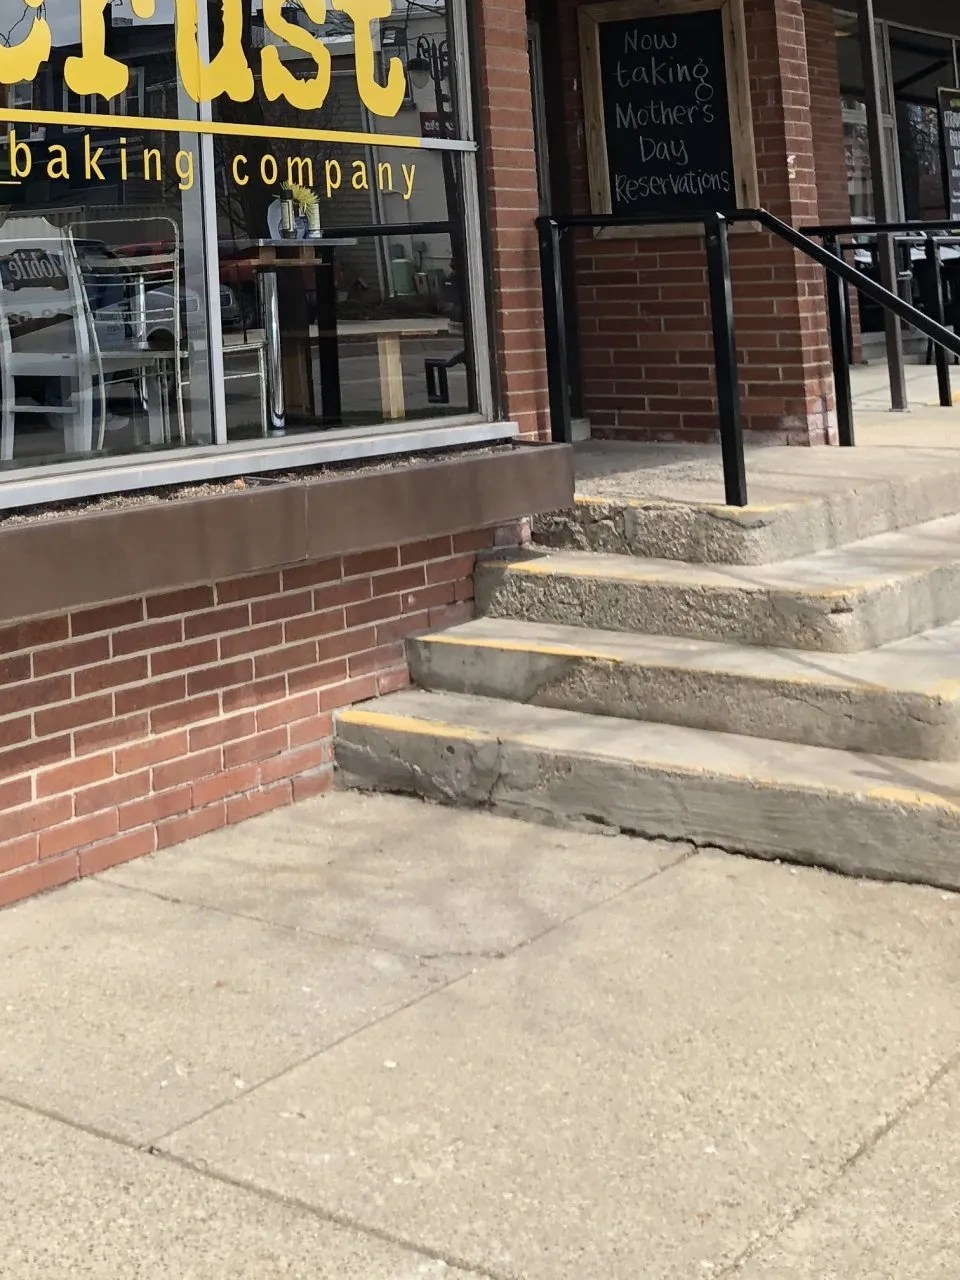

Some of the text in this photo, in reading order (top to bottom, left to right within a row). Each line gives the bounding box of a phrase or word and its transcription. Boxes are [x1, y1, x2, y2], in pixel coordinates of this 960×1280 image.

[624, 29, 678, 54] Now
[611, 56, 714, 102] taking
[615, 100, 715, 129] Mother's
[9, 129, 194, 191] baking
[232, 154, 416, 202] company
[639, 135, 689, 166] Day
[615, 170, 730, 204] Reservations
